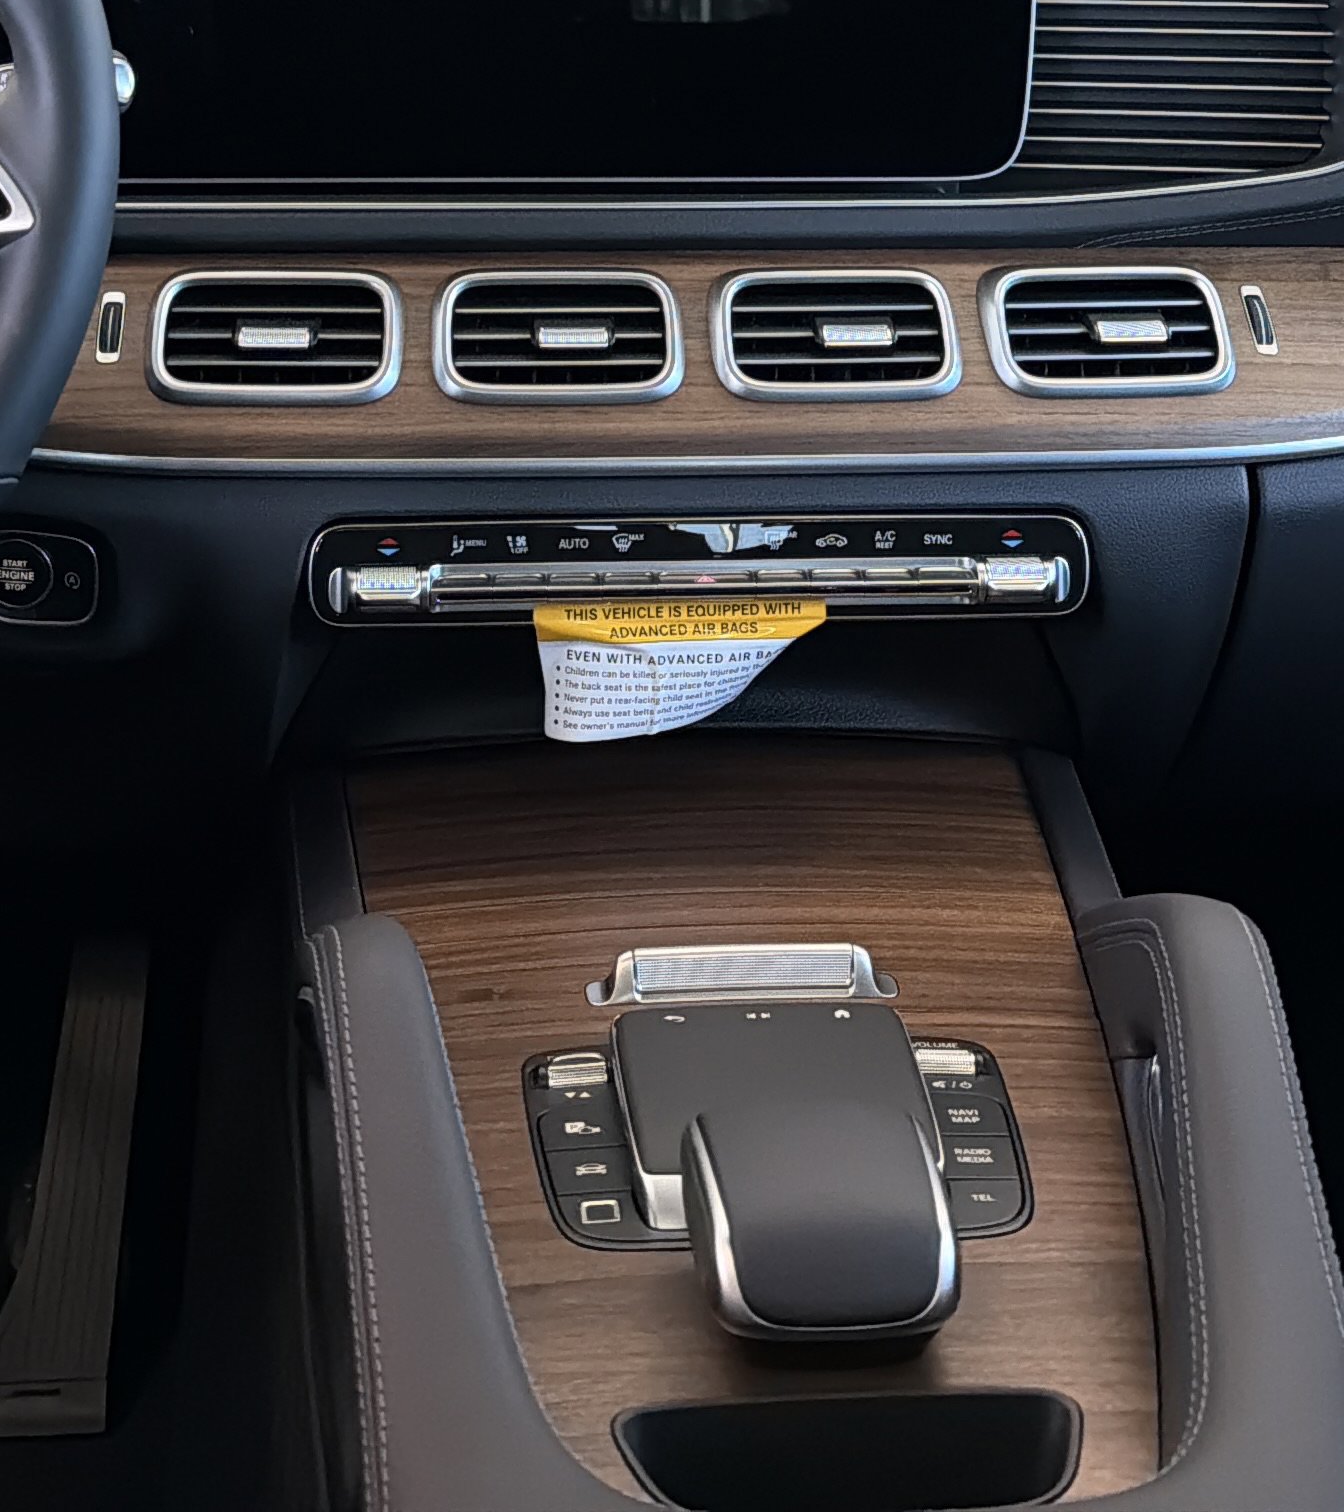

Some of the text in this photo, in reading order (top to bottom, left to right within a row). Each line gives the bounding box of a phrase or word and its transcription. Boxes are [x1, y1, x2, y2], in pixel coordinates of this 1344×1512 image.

[629, 533, 645, 541] MAX
[874, 530, 896, 541] A/C
[924, 534, 953, 545] SYNC
[465, 539, 487, 547] MENU
[559, 537, 590, 550] AUTO
[514, 546, 529, 554] OFF
[2, 559, 28, 567] START
[4, 583, 27, 591] STOP
[564, 602, 801, 621] THIS VEHICLE IS EQUIPPED WITH
[609, 622, 758, 640] ADVANCED AIR BAGS
[566, 649, 601, 663] EVEN
[606, 652, 642, 665] WITH
[647, 653, 723, 666] ADVANCED
[728, 652, 751, 663] AIR
[564, 666, 599, 678] Children
[619, 671, 630, 679] be
[632, 670, 657, 679] killed
[669, 670, 708, 681] seriously
[710, 667, 739, 678] injured
[564, 679, 580, 689] The
[581, 682, 601, 691] back
[604, 684, 622, 692] seat
[625, 684, 632, 692] is
[635, 684, 649, 692] the
[652, 683, 676, 692] safest
[679, 681, 702, 691] place
[704, 680, 715, 688] for
[564, 693, 588, 704] Never
[590, 696, 605, 705] put
[615, 696, 660, 706] rear-facing
[662, 694, 683, 702] child
[685, 692, 702, 701] seat
[563, 706, 592, 719] Always
[612, 709, 631, 717] seat
[633, 708, 654, 717] belts
[657, 706, 672, 714] and
[674, 702, 694, 712] child
[563, 720, 578, 730] See
[580, 722, 614, 730] owner's
[616, 719, 648, 728] manual
[650, 718, 662, 726] for
[947, 1108, 979, 1116] NAVI
[951, 1116, 981, 1124] MAP
[971, 1194, 998, 1202] TEL
